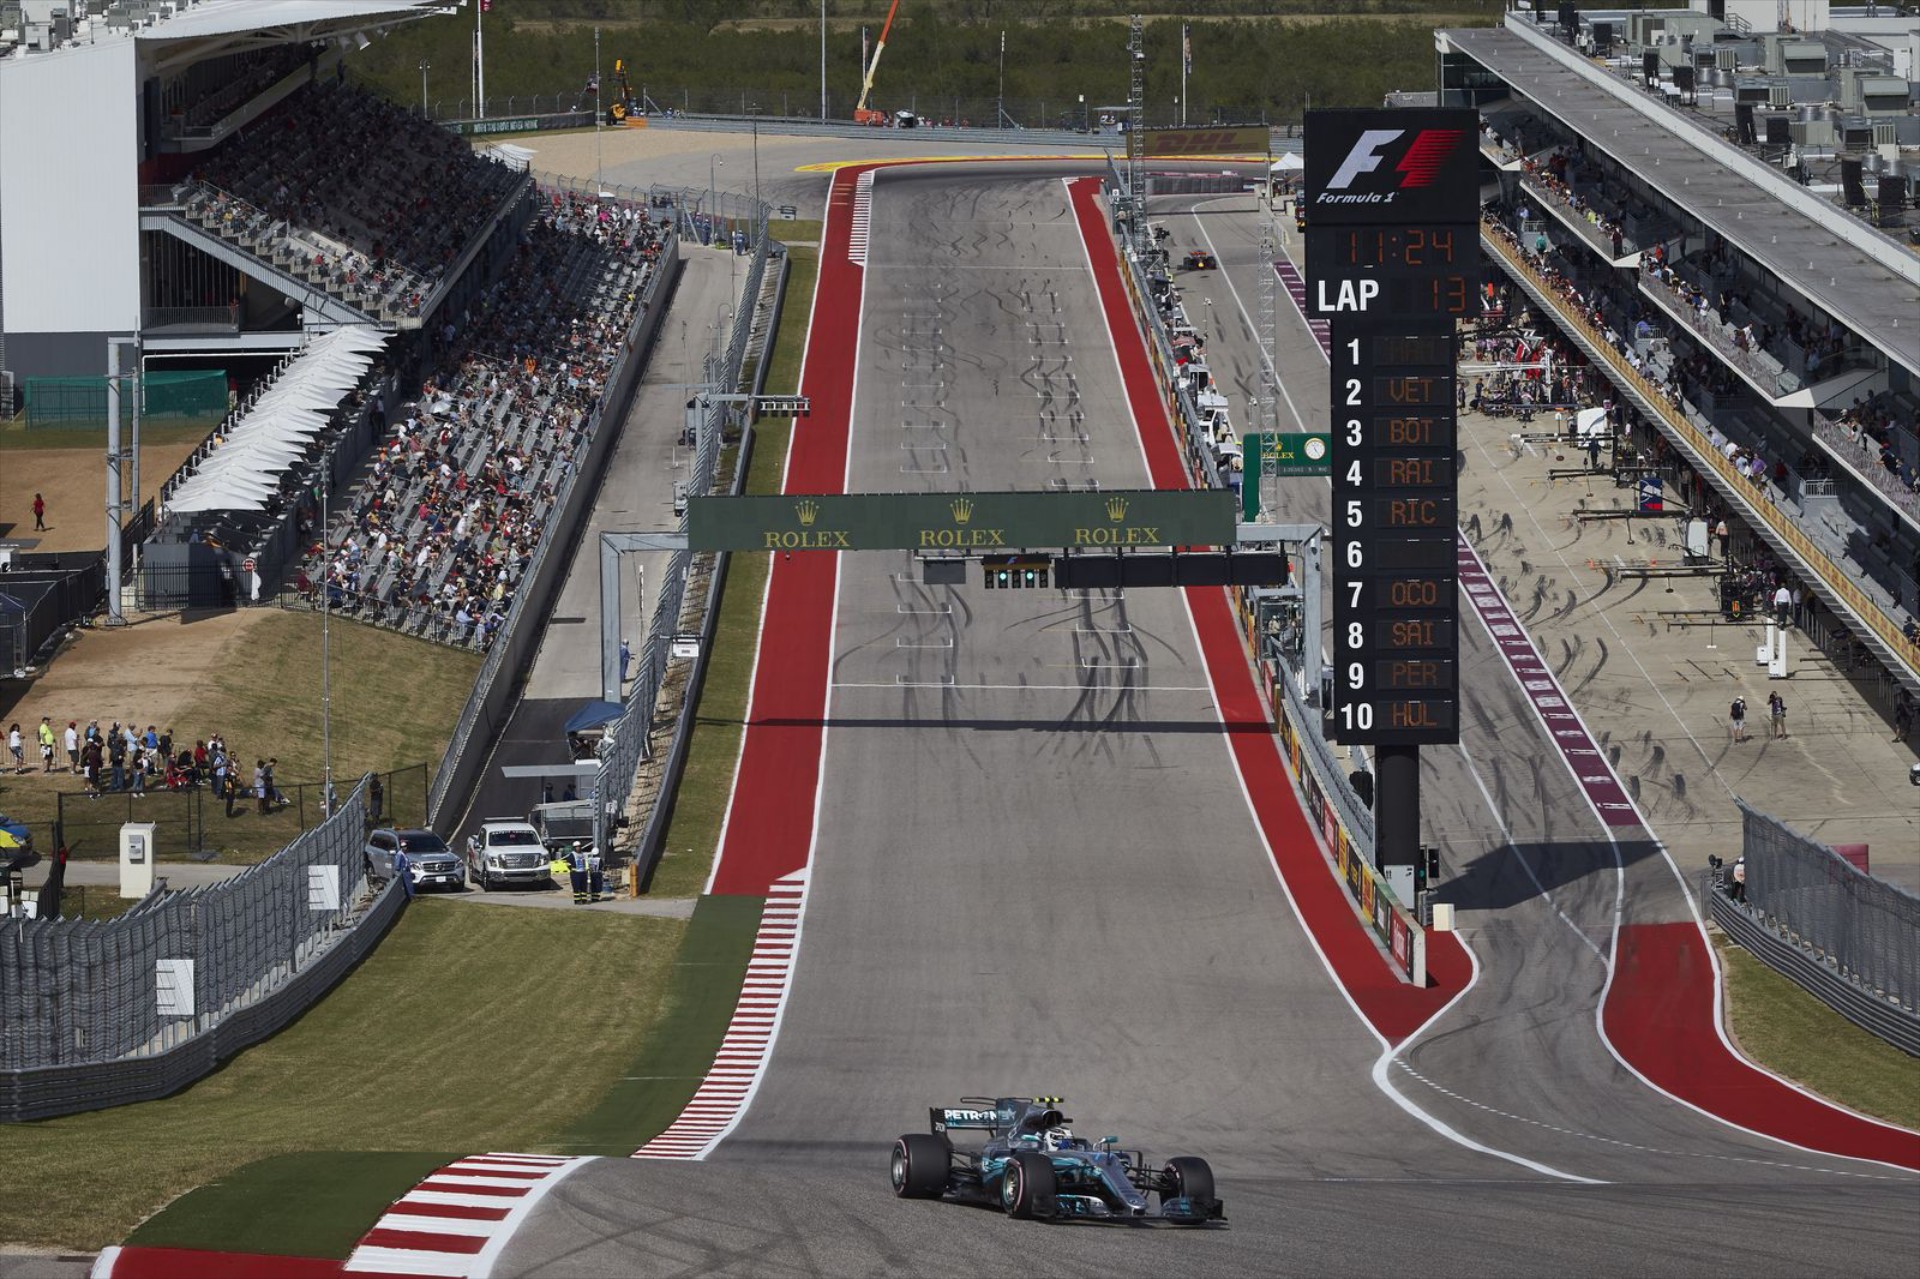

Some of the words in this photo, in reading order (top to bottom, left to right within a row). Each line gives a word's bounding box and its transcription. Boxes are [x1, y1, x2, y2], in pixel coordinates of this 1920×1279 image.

[1155, 131, 1259, 153] DHL
[1316, 192, 1380, 204] Formula
[1352, 230, 1453, 265] 11:24
[1318, 279, 1379, 312] LAP
[1433, 277, 1466, 312] 13
[1347, 338, 1359, 365] 1
[1346, 378, 1362, 405] 2
[1390, 379, 1433, 403] VET
[1346, 419, 1362, 446] 3
[1390, 420, 1433, 444] BOT
[1346, 460, 1362, 486] 4
[1391, 460, 1433, 484] RAI
[1347, 501, 1362, 527] 5
[1391, 501, 1436, 525] RIC
[763, 531, 850, 548] ROLEX
[919, 529, 1006, 546] ROLEX
[1074, 527, 1160, 544] ROLEX
[1347, 541, 1362, 567] 6
[1347, 582, 1363, 608] 7
[1391, 582, 1437, 606] OCO
[1348, 622, 1363, 649] 8
[1392, 622, 1434, 645] SAI
[1349, 662, 1364, 689] 9
[1392, 663, 1437, 687] PER
[1341, 703, 1373, 730] 10
[1393, 702, 1437, 727] HUL
